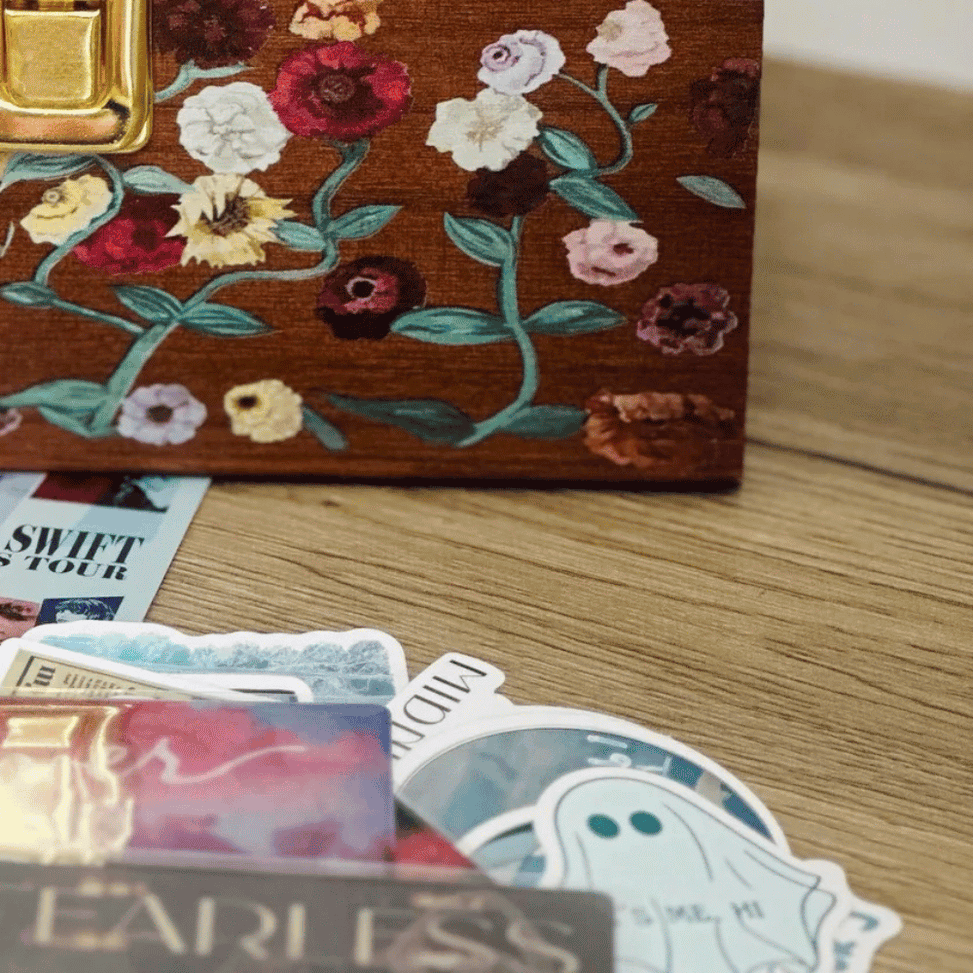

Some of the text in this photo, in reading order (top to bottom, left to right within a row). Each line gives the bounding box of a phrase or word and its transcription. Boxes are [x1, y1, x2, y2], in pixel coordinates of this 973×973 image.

[4, 524, 145, 564] SWIFT
[25, 555, 129, 581] TOUR
[391, 659, 487, 760] MIDN
